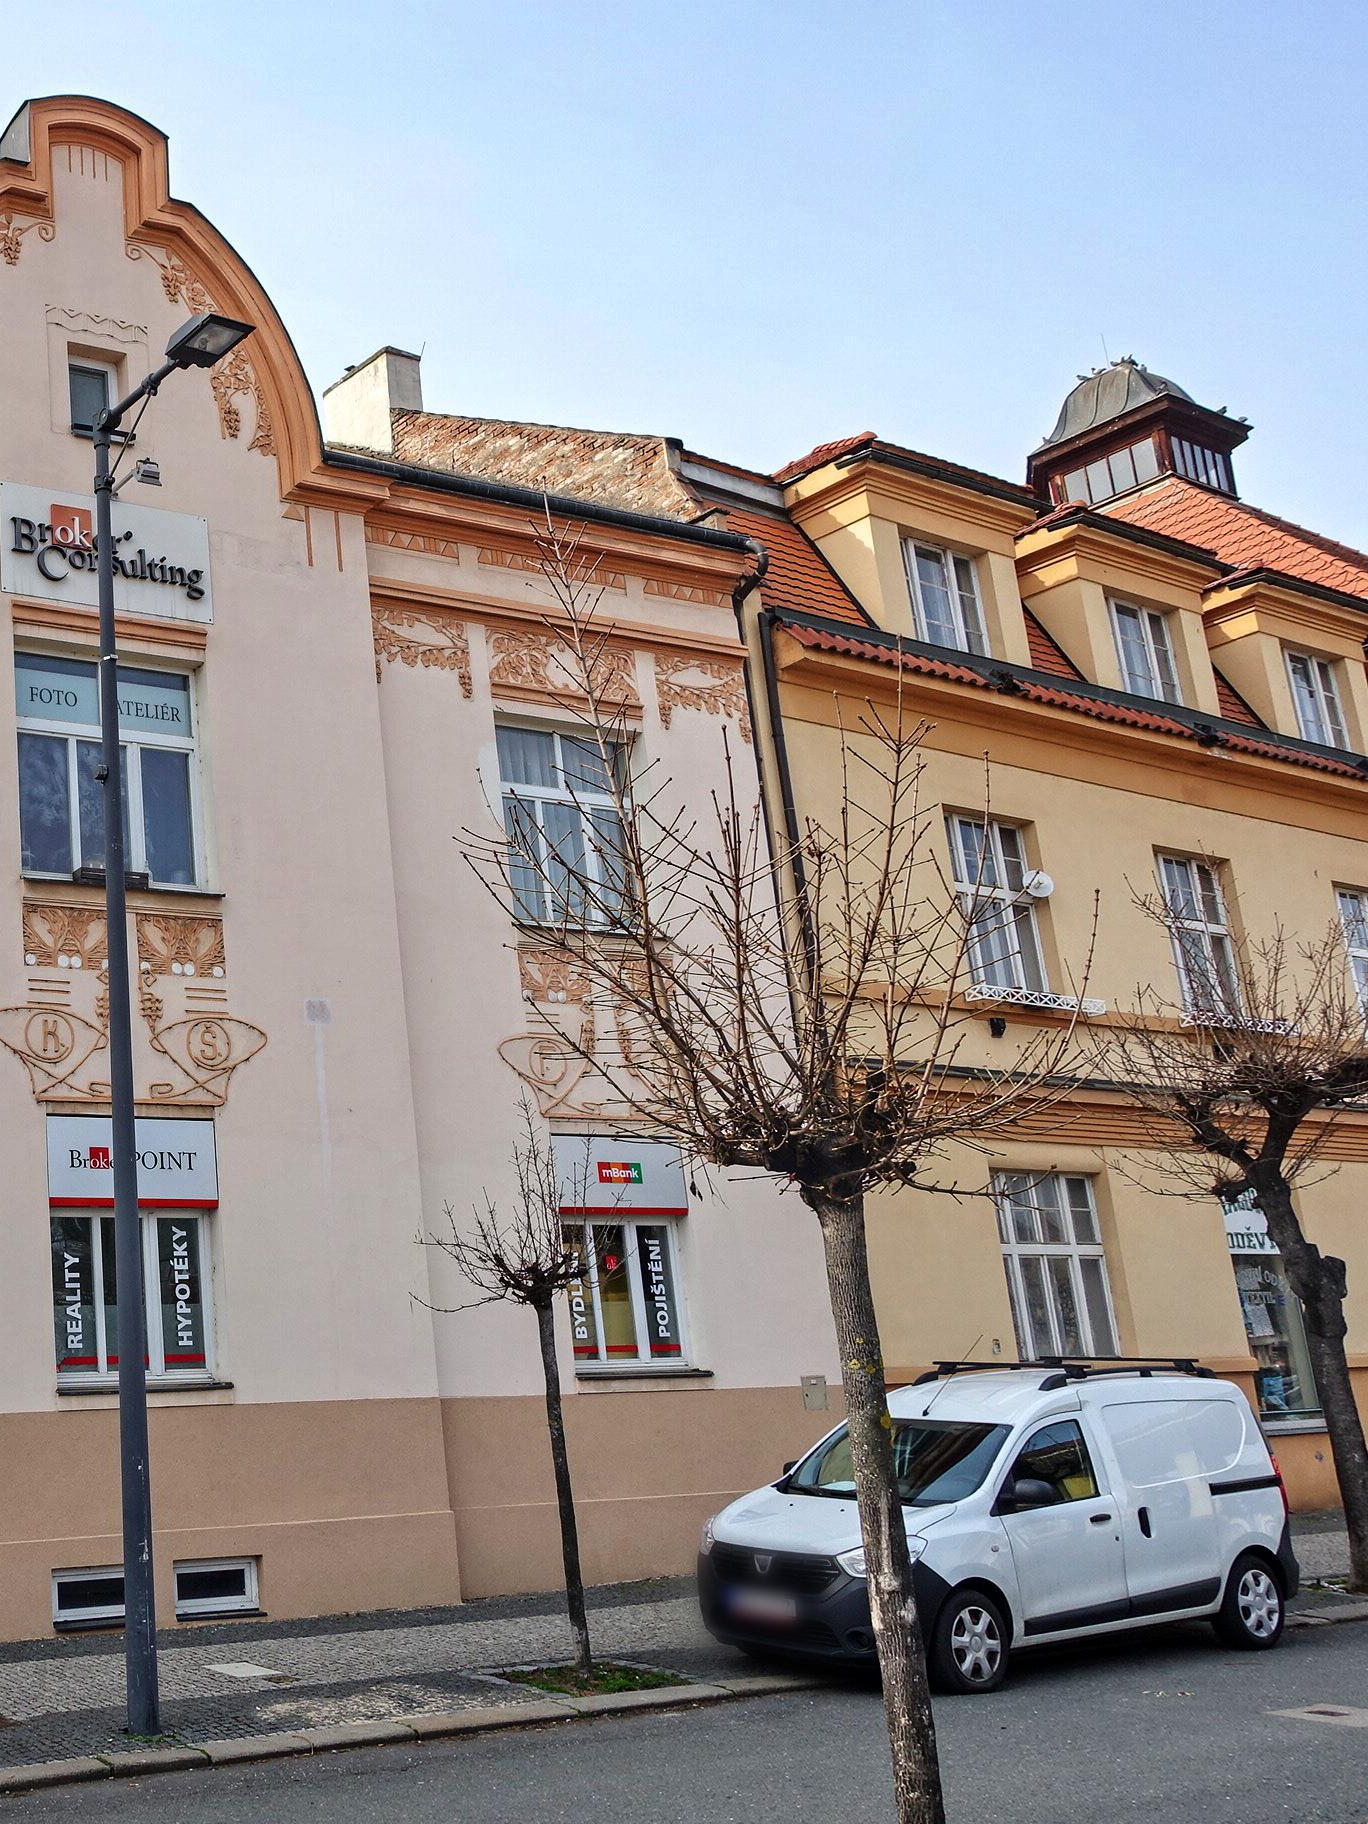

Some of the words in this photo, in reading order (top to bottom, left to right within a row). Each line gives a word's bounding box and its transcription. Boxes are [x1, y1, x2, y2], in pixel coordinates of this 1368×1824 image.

[29, 687, 78, 708] FOTO
[115, 699, 181, 723] ATELIÉR
[602, 1167, 639, 1180] mBank
[63, 1251, 84, 1350] REALITY
[169, 1225, 193, 1347] HYPOTÉKY
[645, 1238, 672, 1339] POJIŠTĚNÍ
